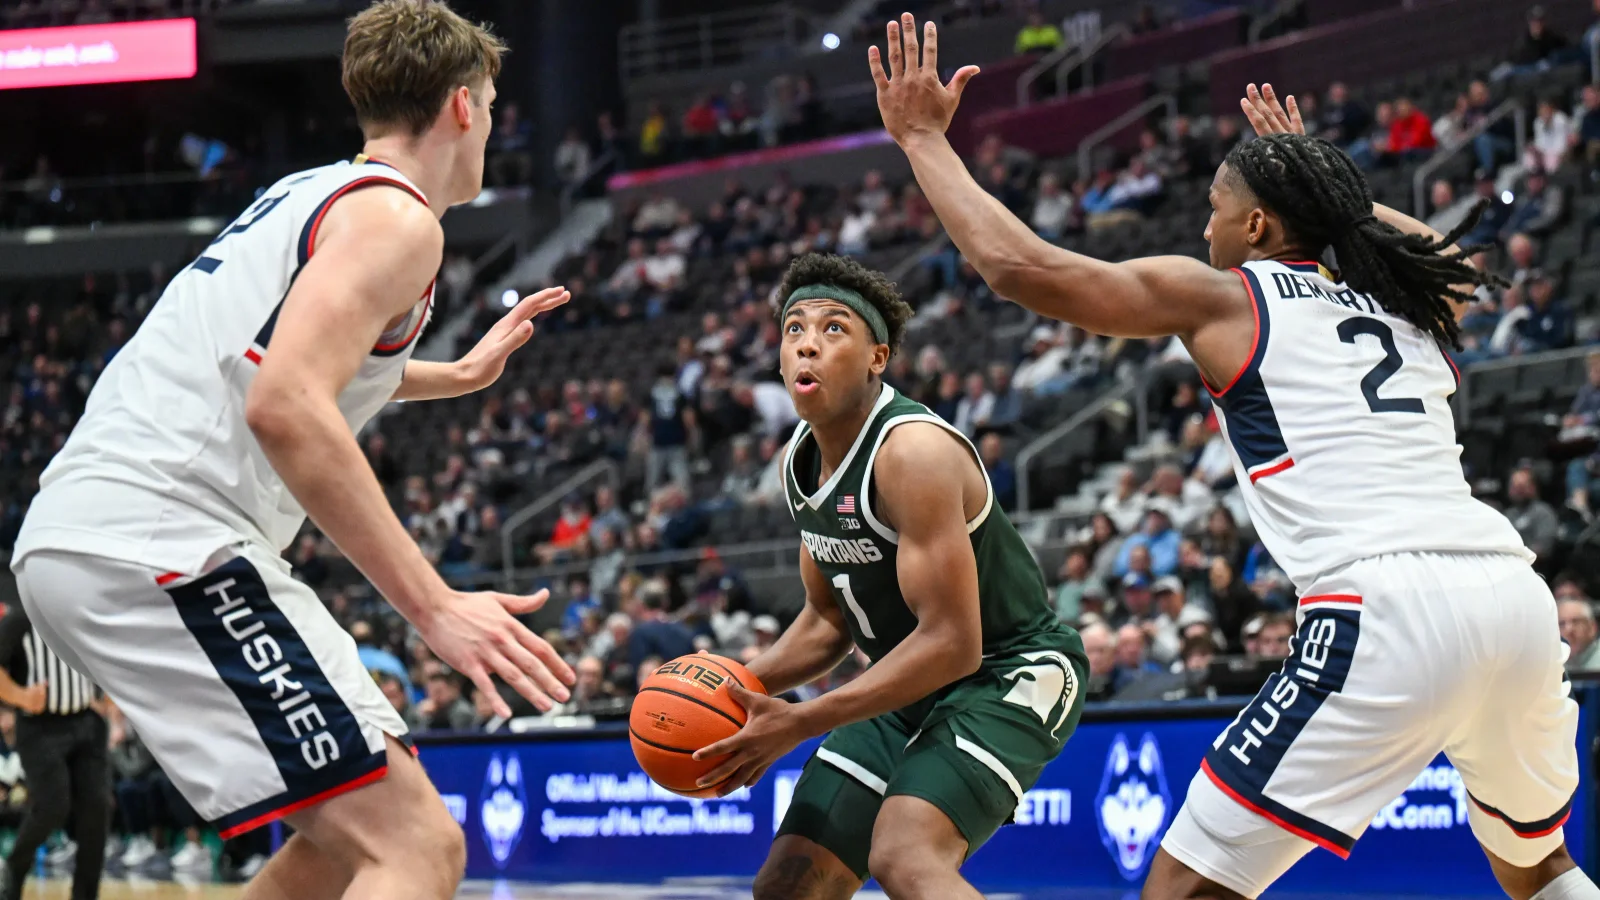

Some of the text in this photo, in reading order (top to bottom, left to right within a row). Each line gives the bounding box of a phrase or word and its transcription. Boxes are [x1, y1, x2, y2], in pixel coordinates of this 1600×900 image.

[1336, 316, 1427, 414] 2
[800, 529, 884, 564] SPARTANS
[832, 573, 877, 639] 1
[203, 577, 340, 770] HUSKIES
[655, 662, 725, 691] ELITE
[1229, 618, 1336, 766] HUSIES
[1016, 788, 1072, 826] ETTI
